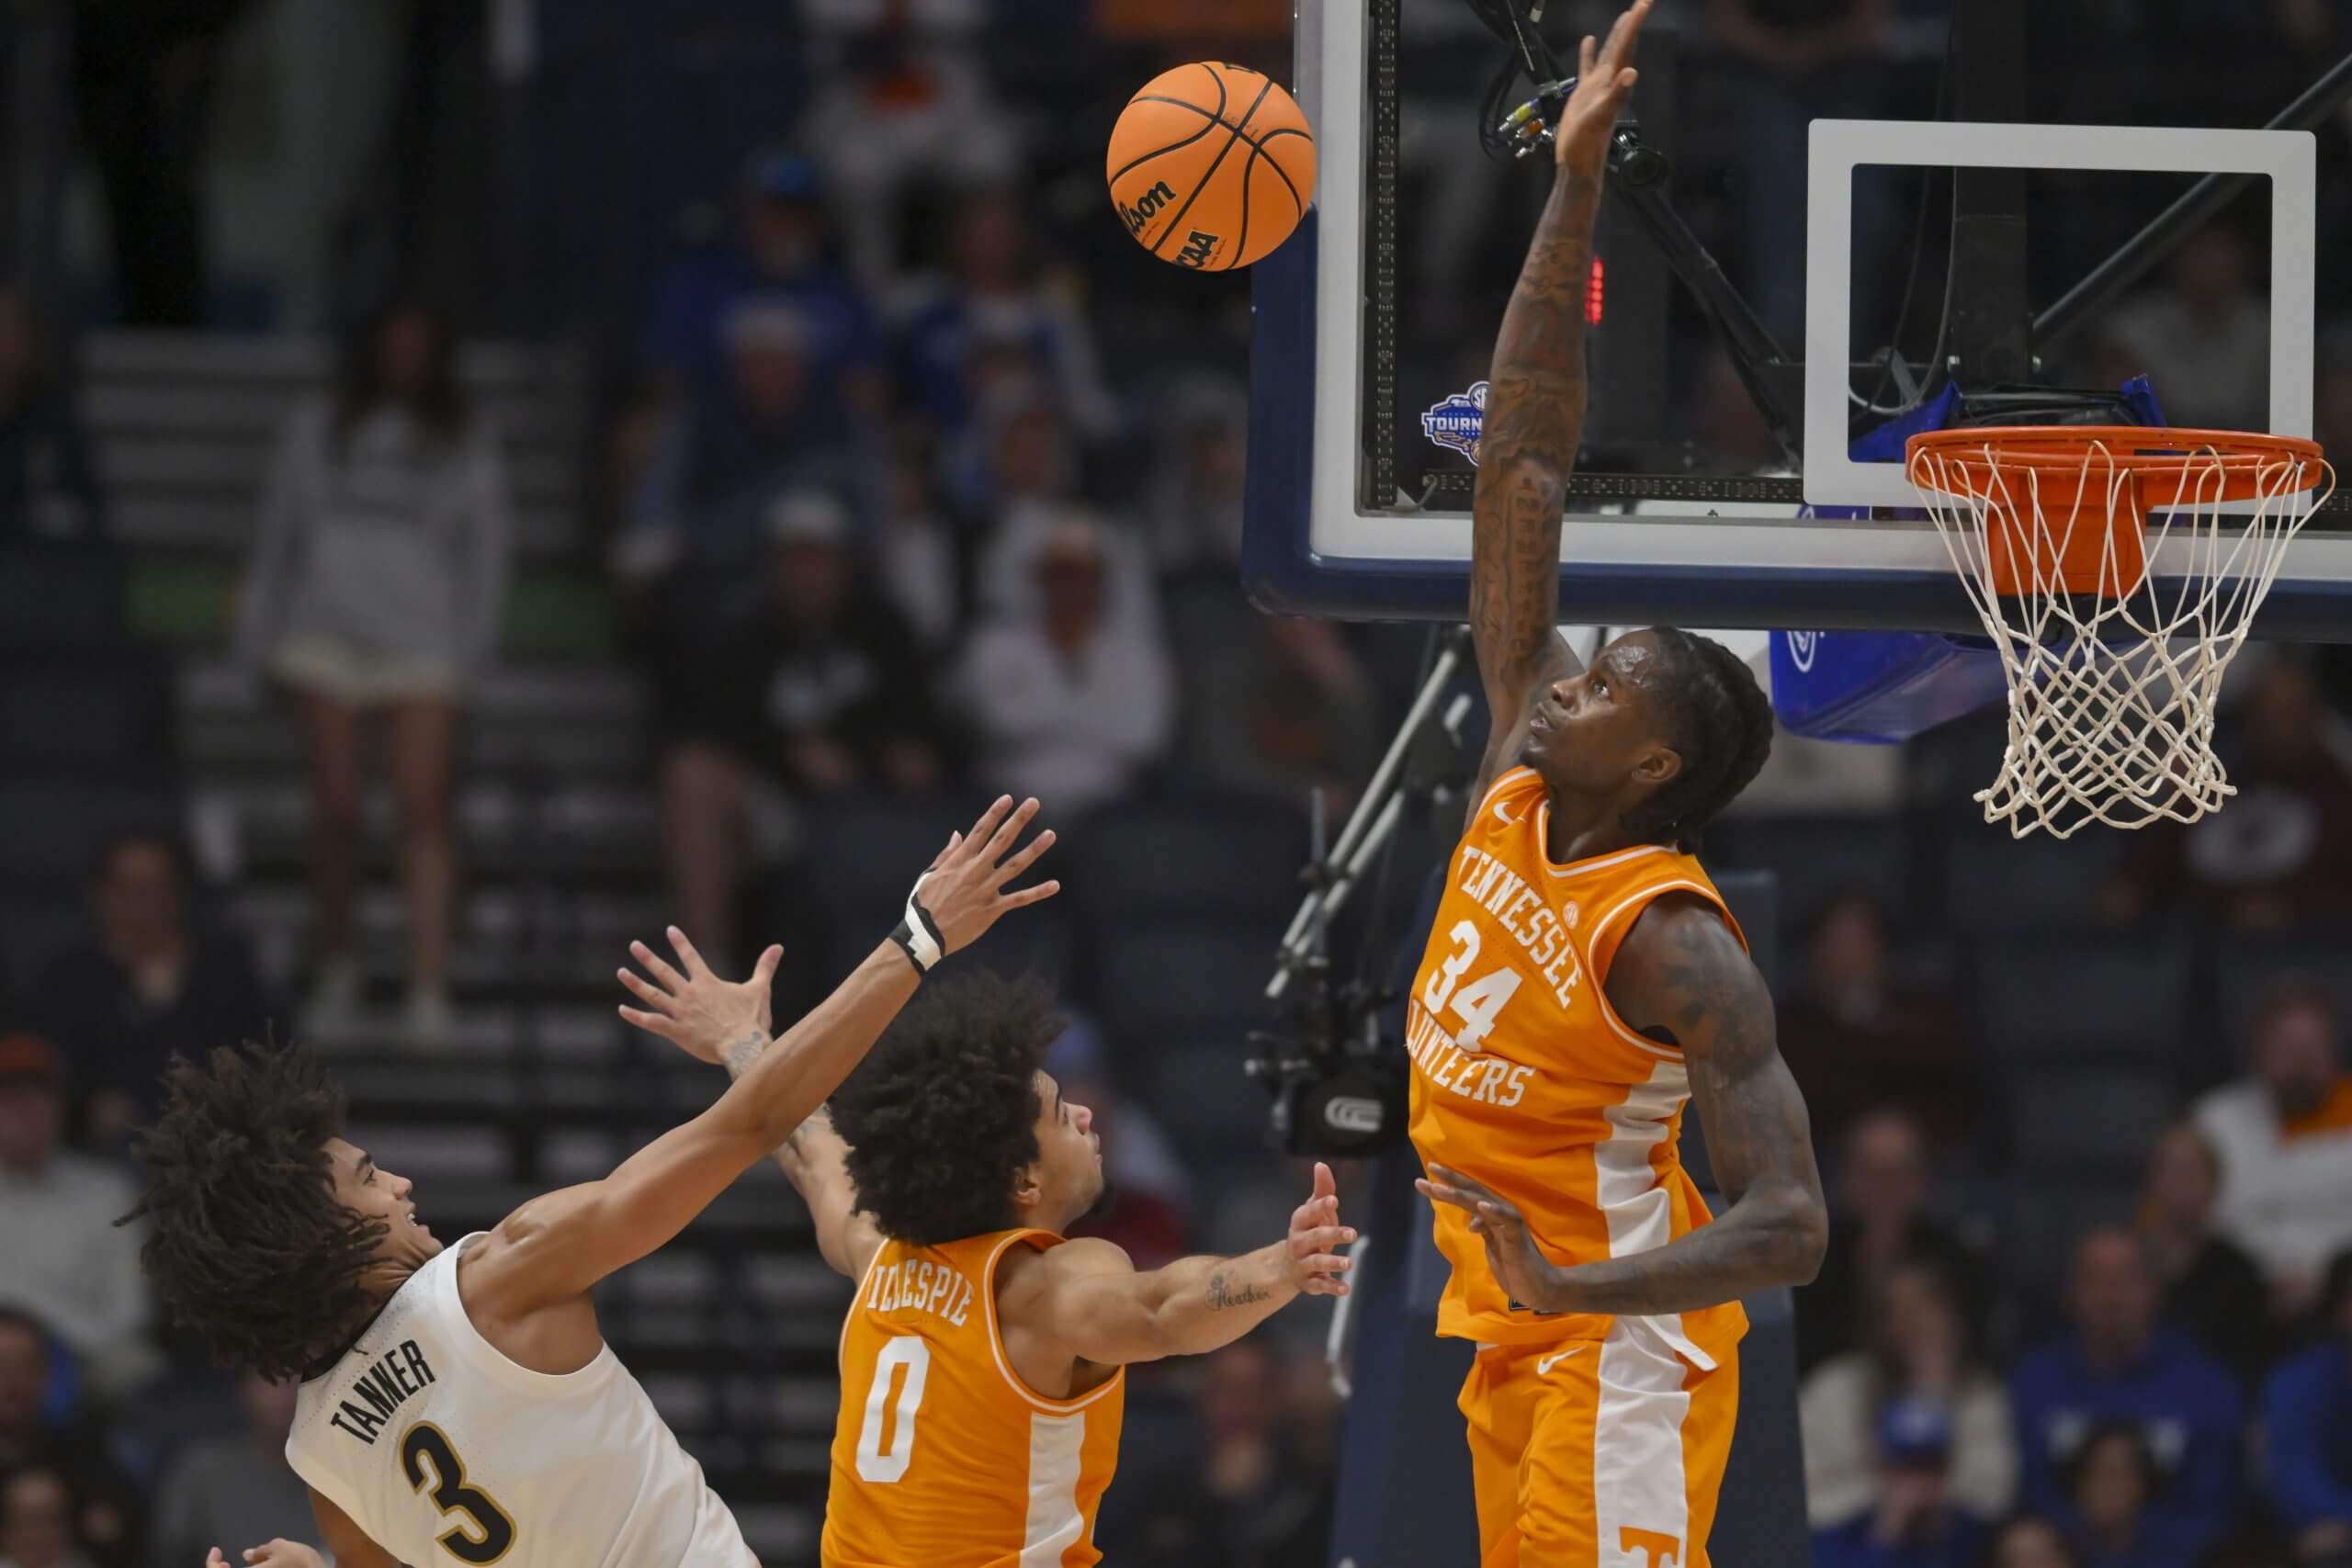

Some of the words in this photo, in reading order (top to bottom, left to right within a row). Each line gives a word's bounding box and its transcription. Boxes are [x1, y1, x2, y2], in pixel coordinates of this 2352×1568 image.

[1425, 416, 1484, 434] TOURN
[1424, 919, 1523, 1054] 34
[1456, 843, 1584, 1010] TENNESSEE
[330, 1338, 436, 1446] TANNER
[854, 1335, 931, 1483] 0
[399, 1419, 518, 1567] 3
